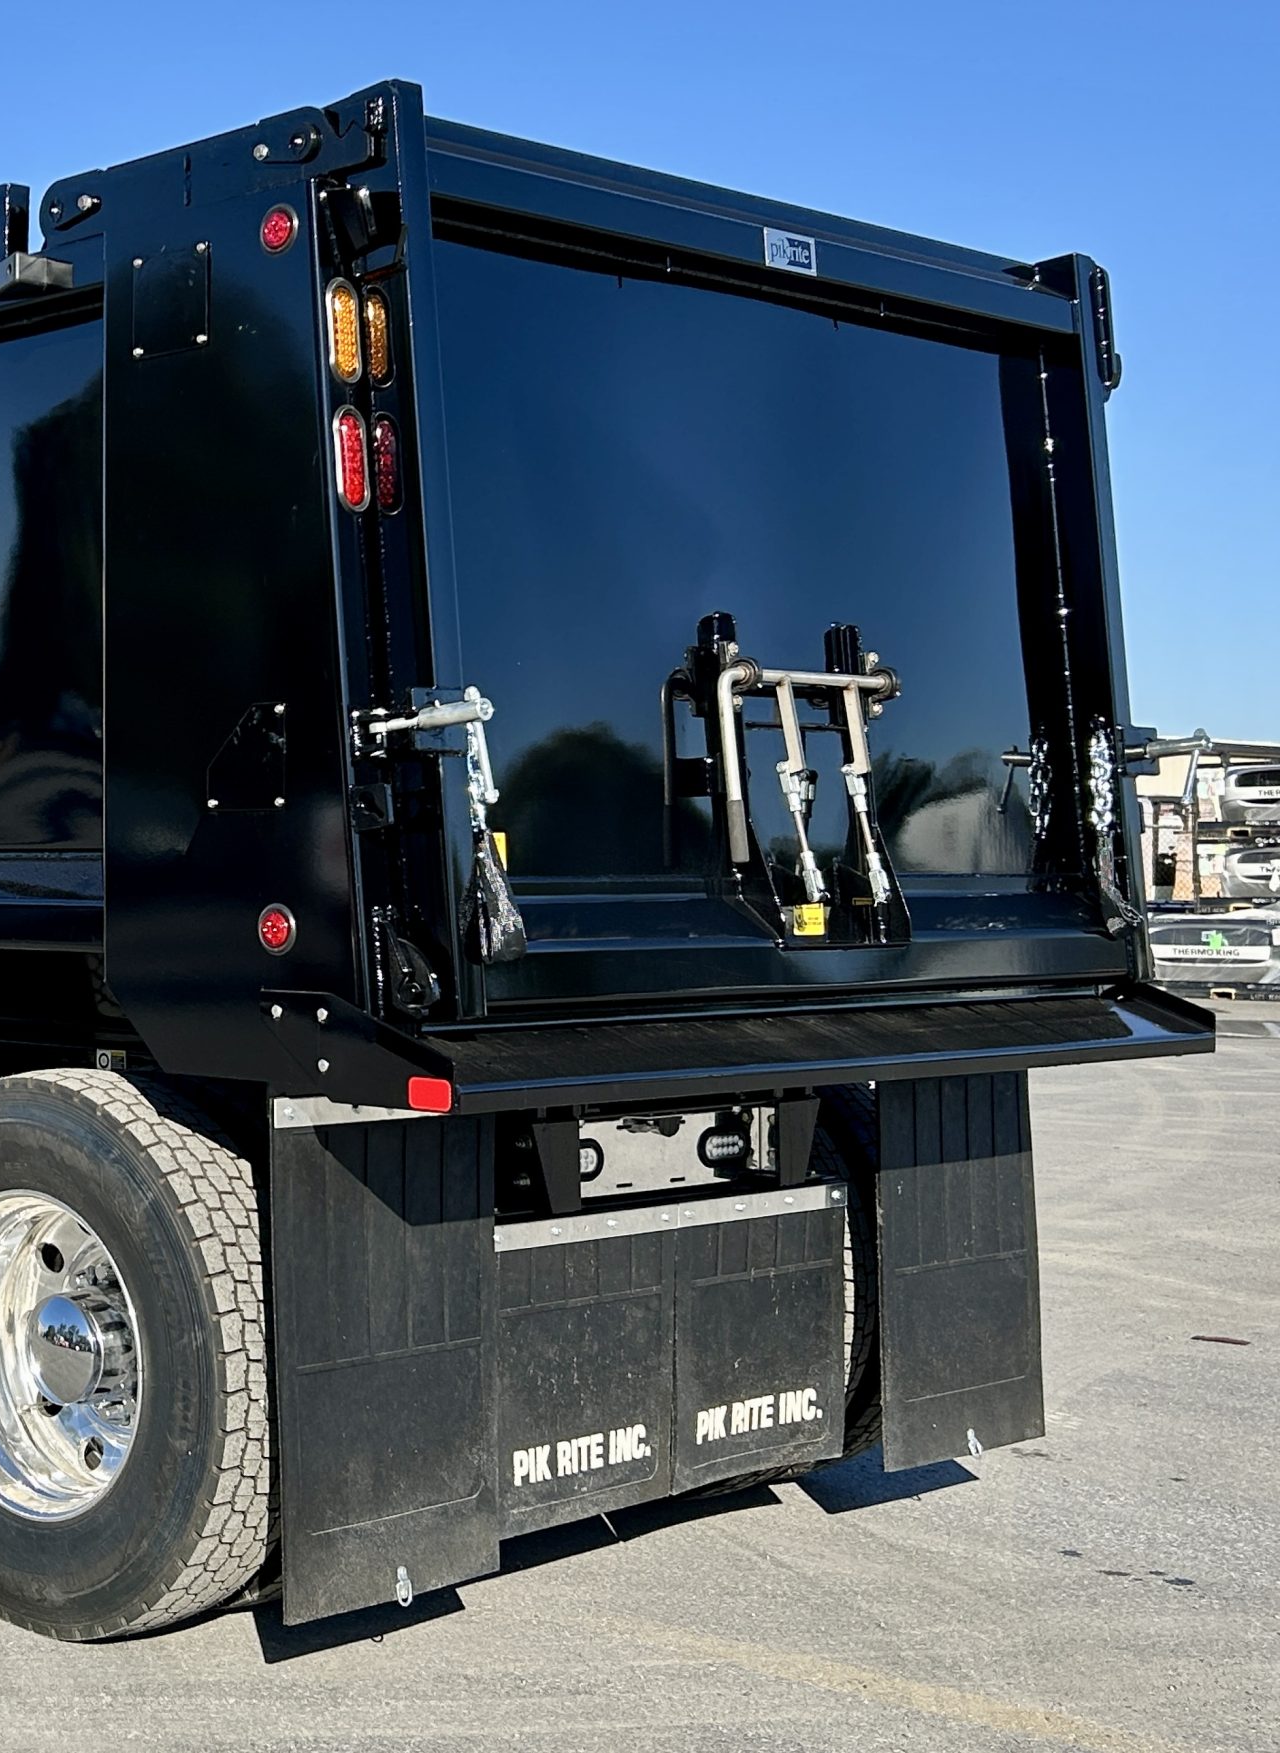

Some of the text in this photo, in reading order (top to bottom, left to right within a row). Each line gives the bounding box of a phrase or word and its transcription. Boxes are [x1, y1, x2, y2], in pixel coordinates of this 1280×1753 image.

[1173, 947, 1214, 956] THERMO
[696, 1388, 823, 1445] PIK RITE INC.
[513, 1424, 651, 1487] PIK RITE INC.
